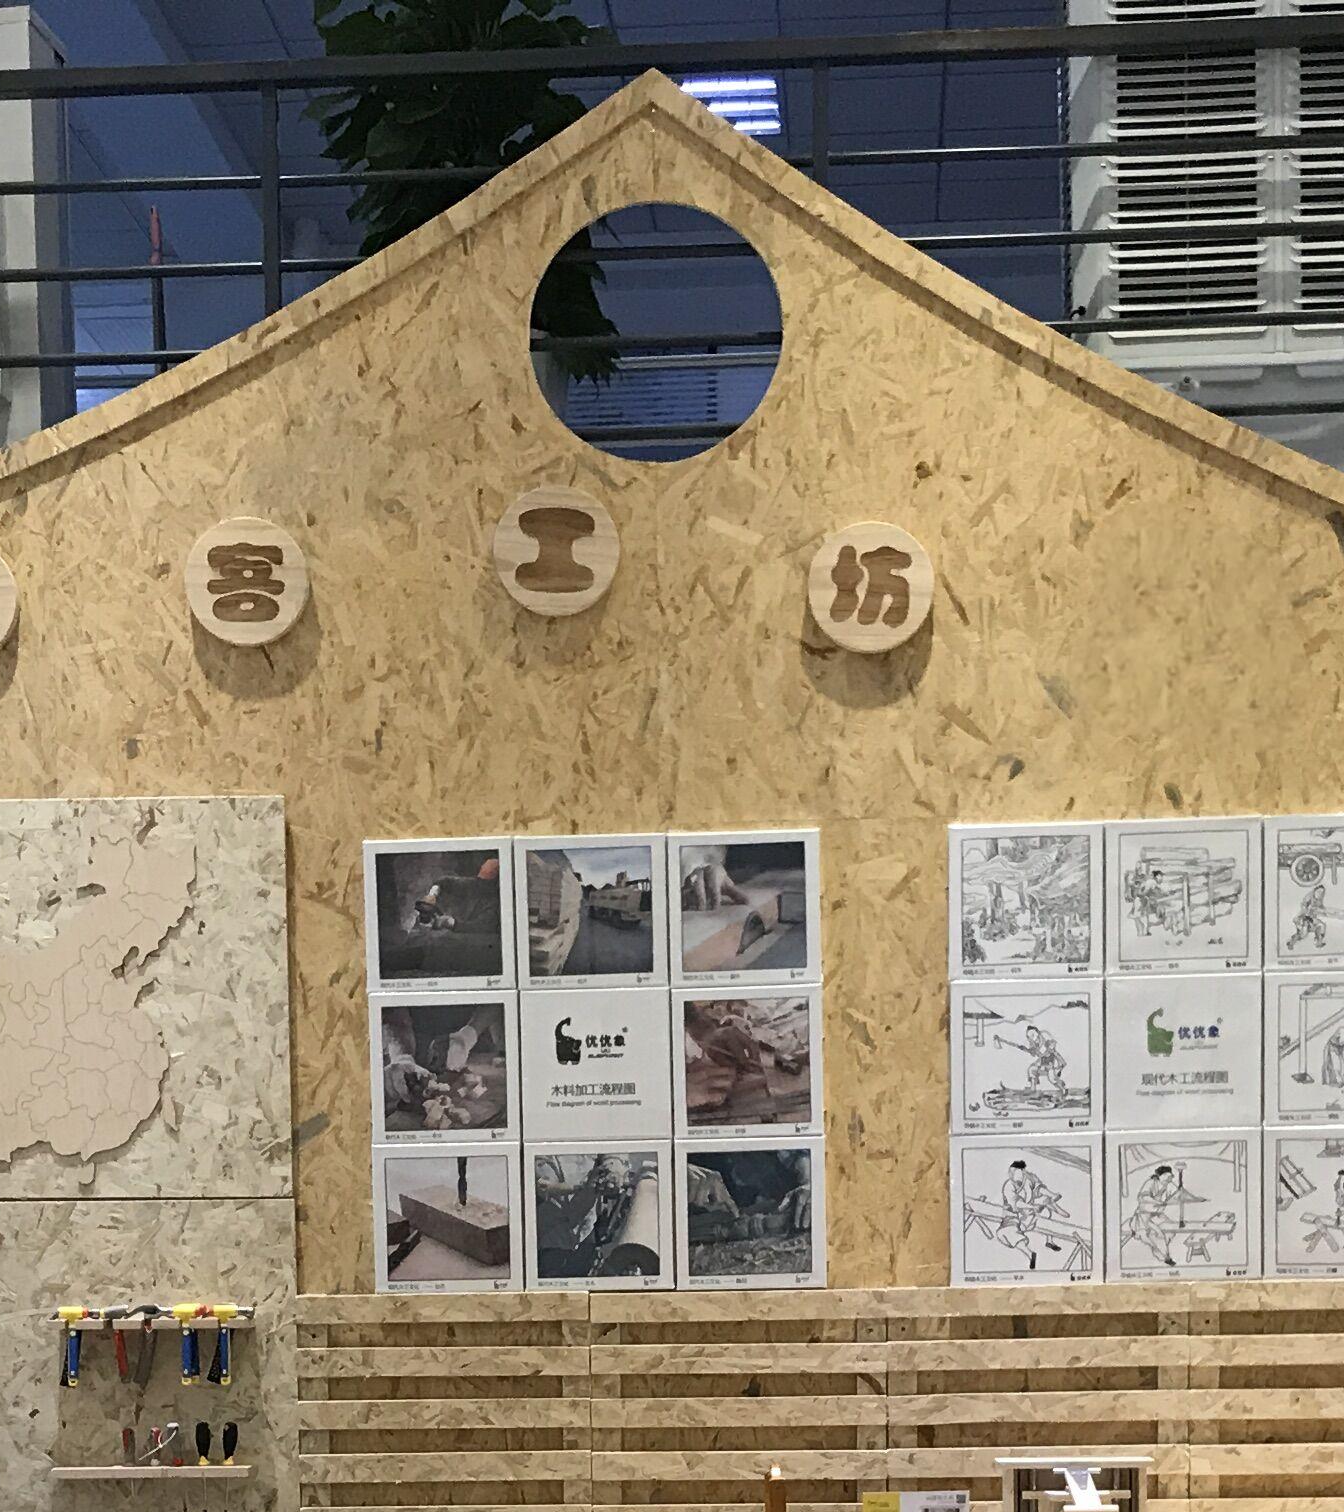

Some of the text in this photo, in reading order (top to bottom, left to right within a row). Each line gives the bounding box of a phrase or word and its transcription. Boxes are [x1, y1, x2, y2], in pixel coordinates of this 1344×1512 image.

[514, 506, 596, 594] 工
[829, 544, 912, 629] 坊
[550, 1081, 636, 1097] 木料加工流程图
